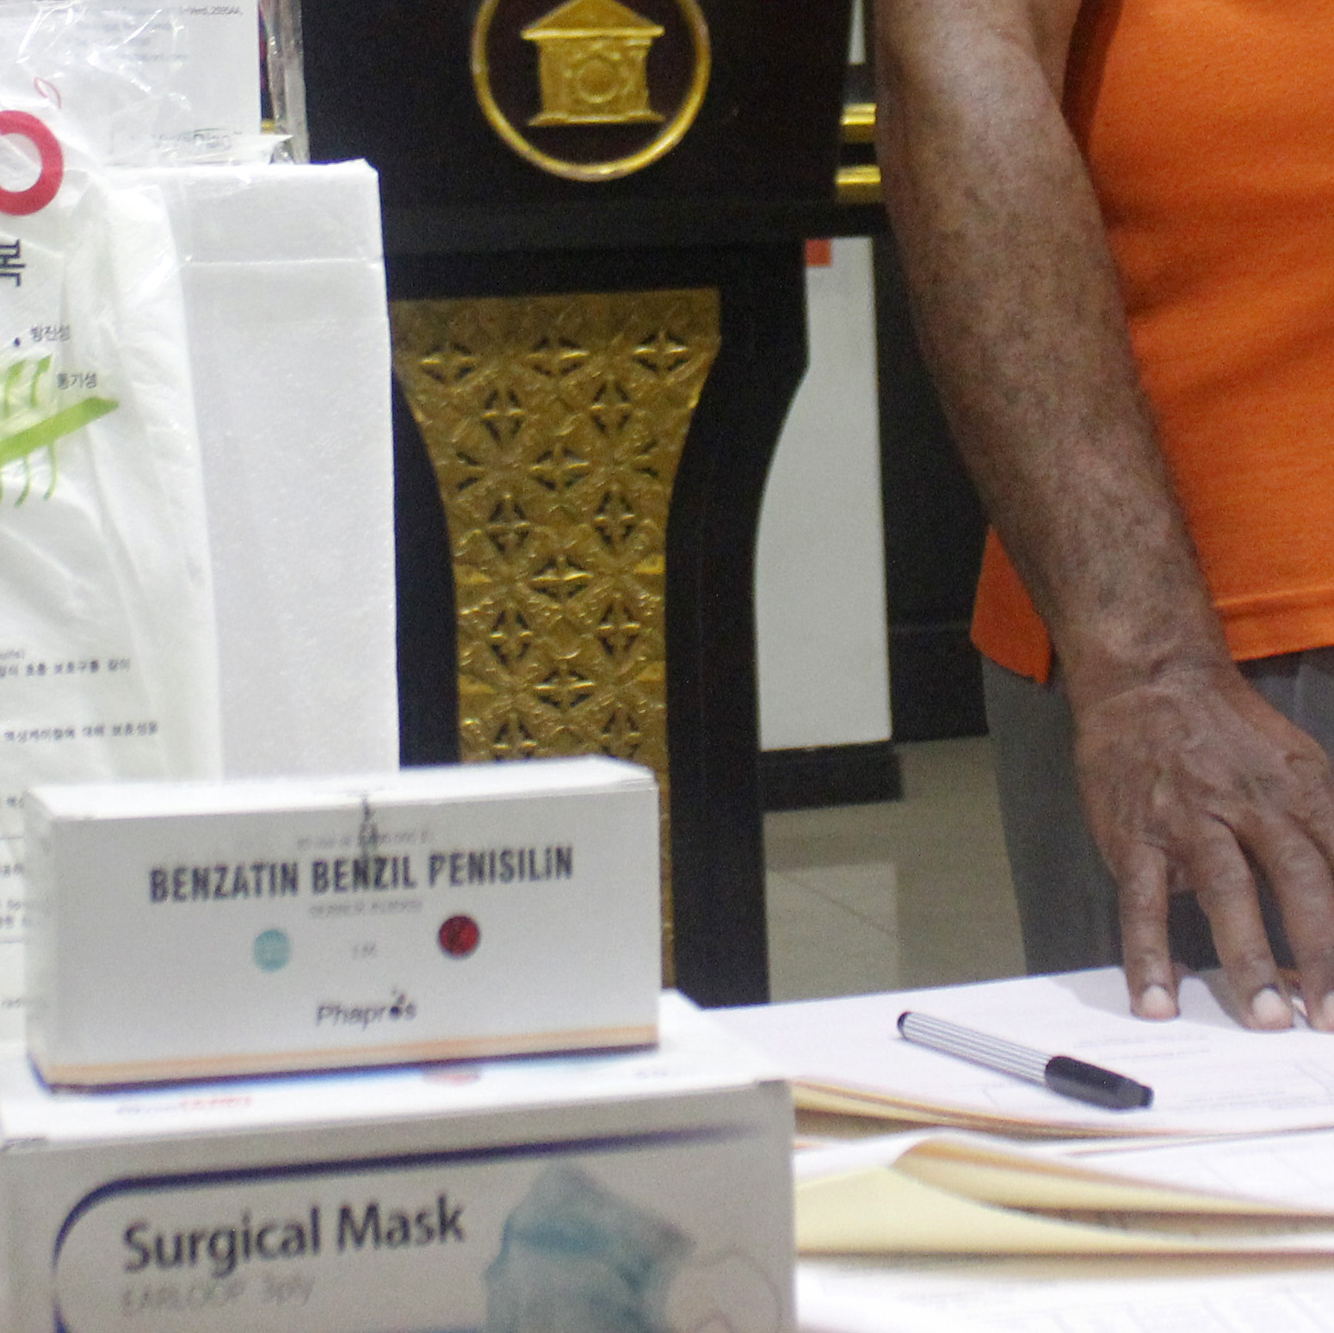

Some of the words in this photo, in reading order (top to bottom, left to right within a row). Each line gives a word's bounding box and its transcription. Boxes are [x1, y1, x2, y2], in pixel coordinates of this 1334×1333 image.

[149, 860, 300, 906] BENZATIN
[310, 854, 418, 895] BENZIL
[428, 846, 575, 887] PENISILIN
[122, 1203, 320, 1279] Surgical
[335, 1193, 466, 1254] Mask
